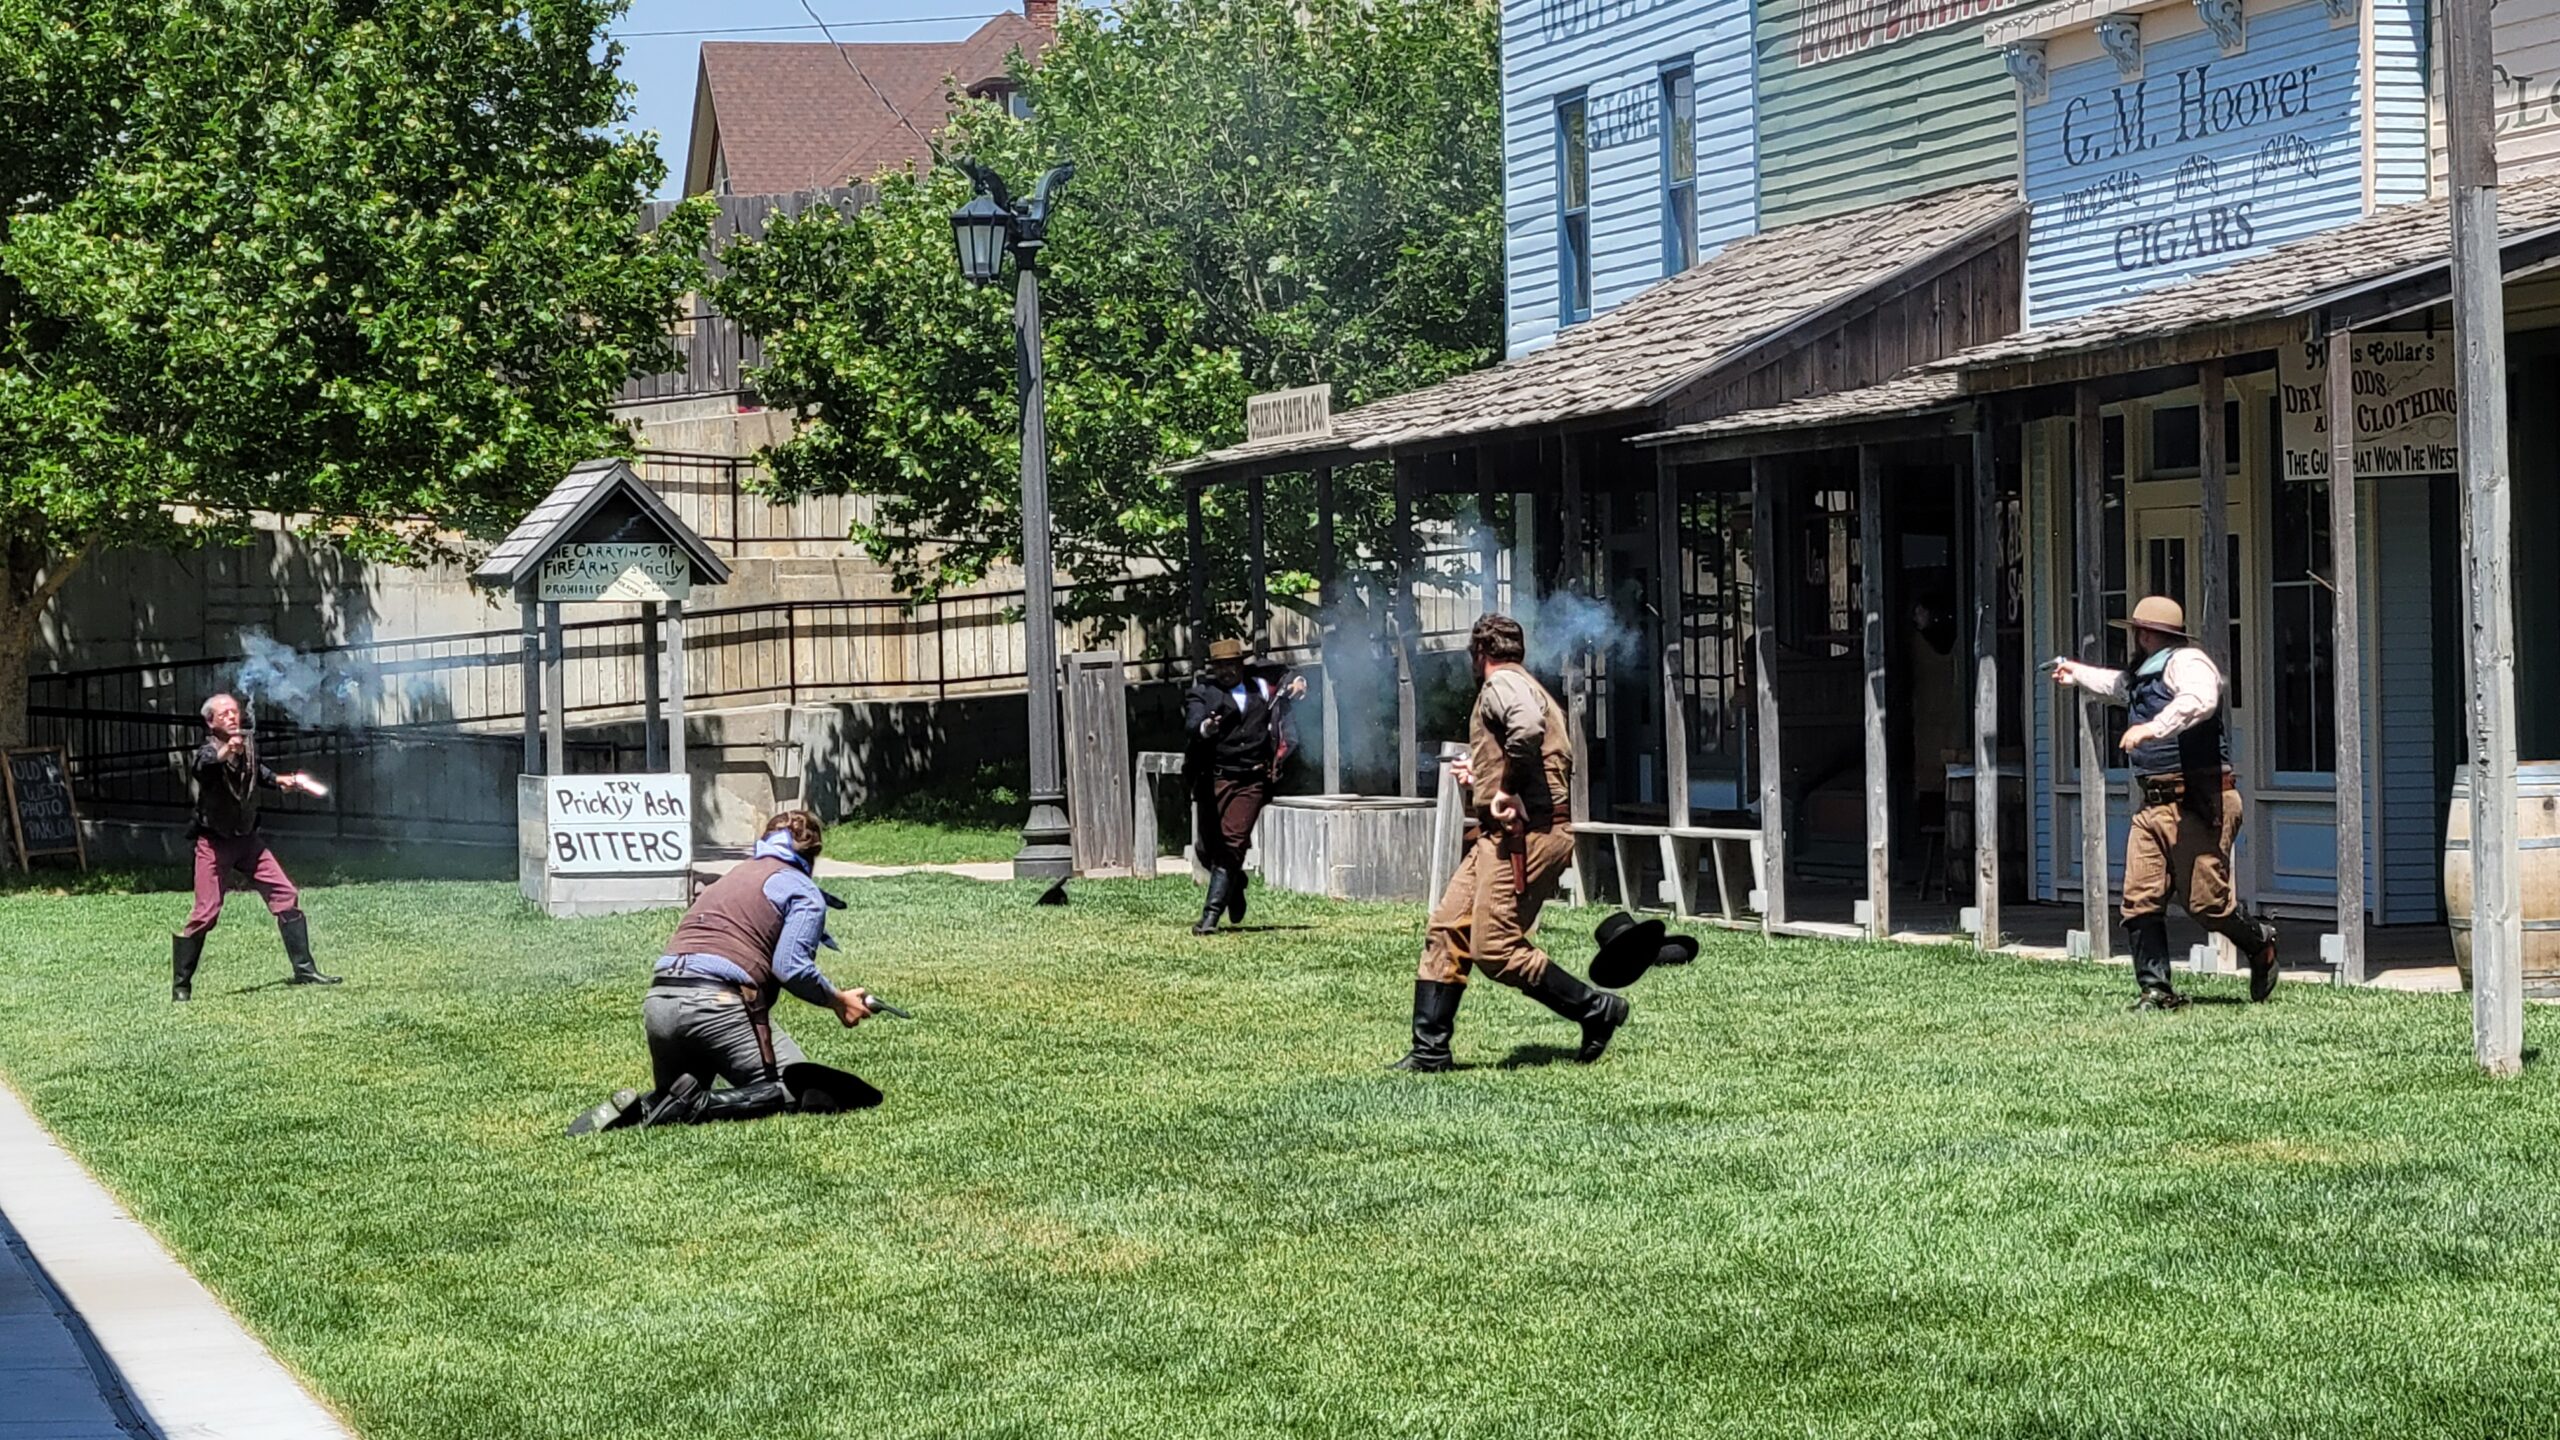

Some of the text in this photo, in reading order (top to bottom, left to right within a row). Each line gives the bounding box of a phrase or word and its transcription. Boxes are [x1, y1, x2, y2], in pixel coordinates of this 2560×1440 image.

[1590, 82, 1658, 150] STORE
[2176, 64, 2317, 143] Hoover
[2114, 202, 2255, 272] CIGARS
[2283, 369, 2386, 413] DRY ODS
[2357, 388, 2458, 432] CLOTHING
[2311, 448, 2328, 475] GU
[2353, 450, 2371, 473] HAT
[573, 543, 651, 558] CARRYING
[658, 544, 678, 558] OF
[544, 584, 608, 594] PROHIBITED
[14, 760, 41, 780] OLD
[23, 782, 63, 801] WEST
[604, 781, 641, 795] TRY
[20, 799, 63, 817] PHOTO
[556, 789, 686, 821] Prickly Ash
[554, 830, 683, 863] BITTERS
